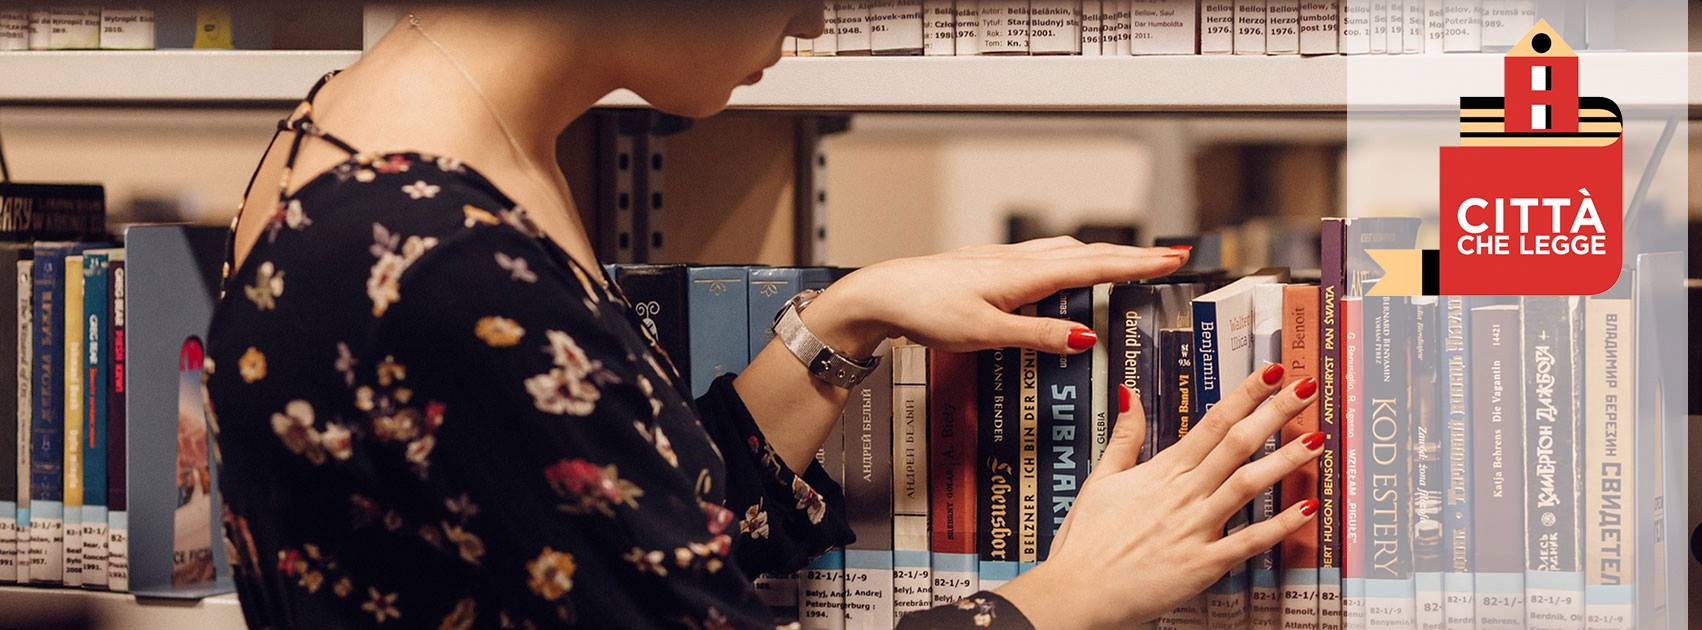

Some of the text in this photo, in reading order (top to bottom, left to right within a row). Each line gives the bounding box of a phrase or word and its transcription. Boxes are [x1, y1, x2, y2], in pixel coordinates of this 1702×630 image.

[1160, 9, 1175, 17] Saul
[1271, 28, 1296, 36] 1976.
[1323, 285, 1335, 325] ŚWIATA
[1126, 310, 1142, 347] david
[1291, 307, 1305, 370] P. Benoit
[1323, 328, 1334, 350] PAN
[1199, 322, 1216, 391] Benjamin
[1383, 338, 1391, 382] BENYAMIN
[1605, 313, 1619, 389] ВЛАДИМИР
[1179, 374, 1189, 386] VI
[1323, 356, 1334, 424] ANTYCHRYST
[1490, 360, 1503, 403] Vagantin
[861, 388, 872, 431] БЕЛЫЙ
[1024, 395, 1036, 420] DER
[1178, 388, 1189, 413] Band
[1492, 405, 1503, 421] Die
[1024, 427, 1036, 452] BIN
[1096, 412, 1107, 444] GŁĘBIA
[1346, 407, 1356, 438] Agasso
[1605, 394, 1618, 456] БЕРЕЗИН
[1492, 428, 1504, 468] Behrens
[1024, 457, 1036, 479] ICH
[1324, 450, 1333, 496] BENSON
[1346, 448, 1357, 495] WZIĘŁAM
[1493, 471, 1504, 497] Katja
[1372, 397, 1398, 577] KOD ESTERY
[986, 455, 1013, 560] Lebensbor
[1024, 495, 1036, 554] BELZNER
[1324, 498, 1333, 542] HUGON
[854, 590, 882, 599] Andrej
[934, 578, 970, 588] 82-1/-9
[1530, 595, 1572, 605] 82-1/-9
[1370, 607, 1402, 615] 82-1/-9
